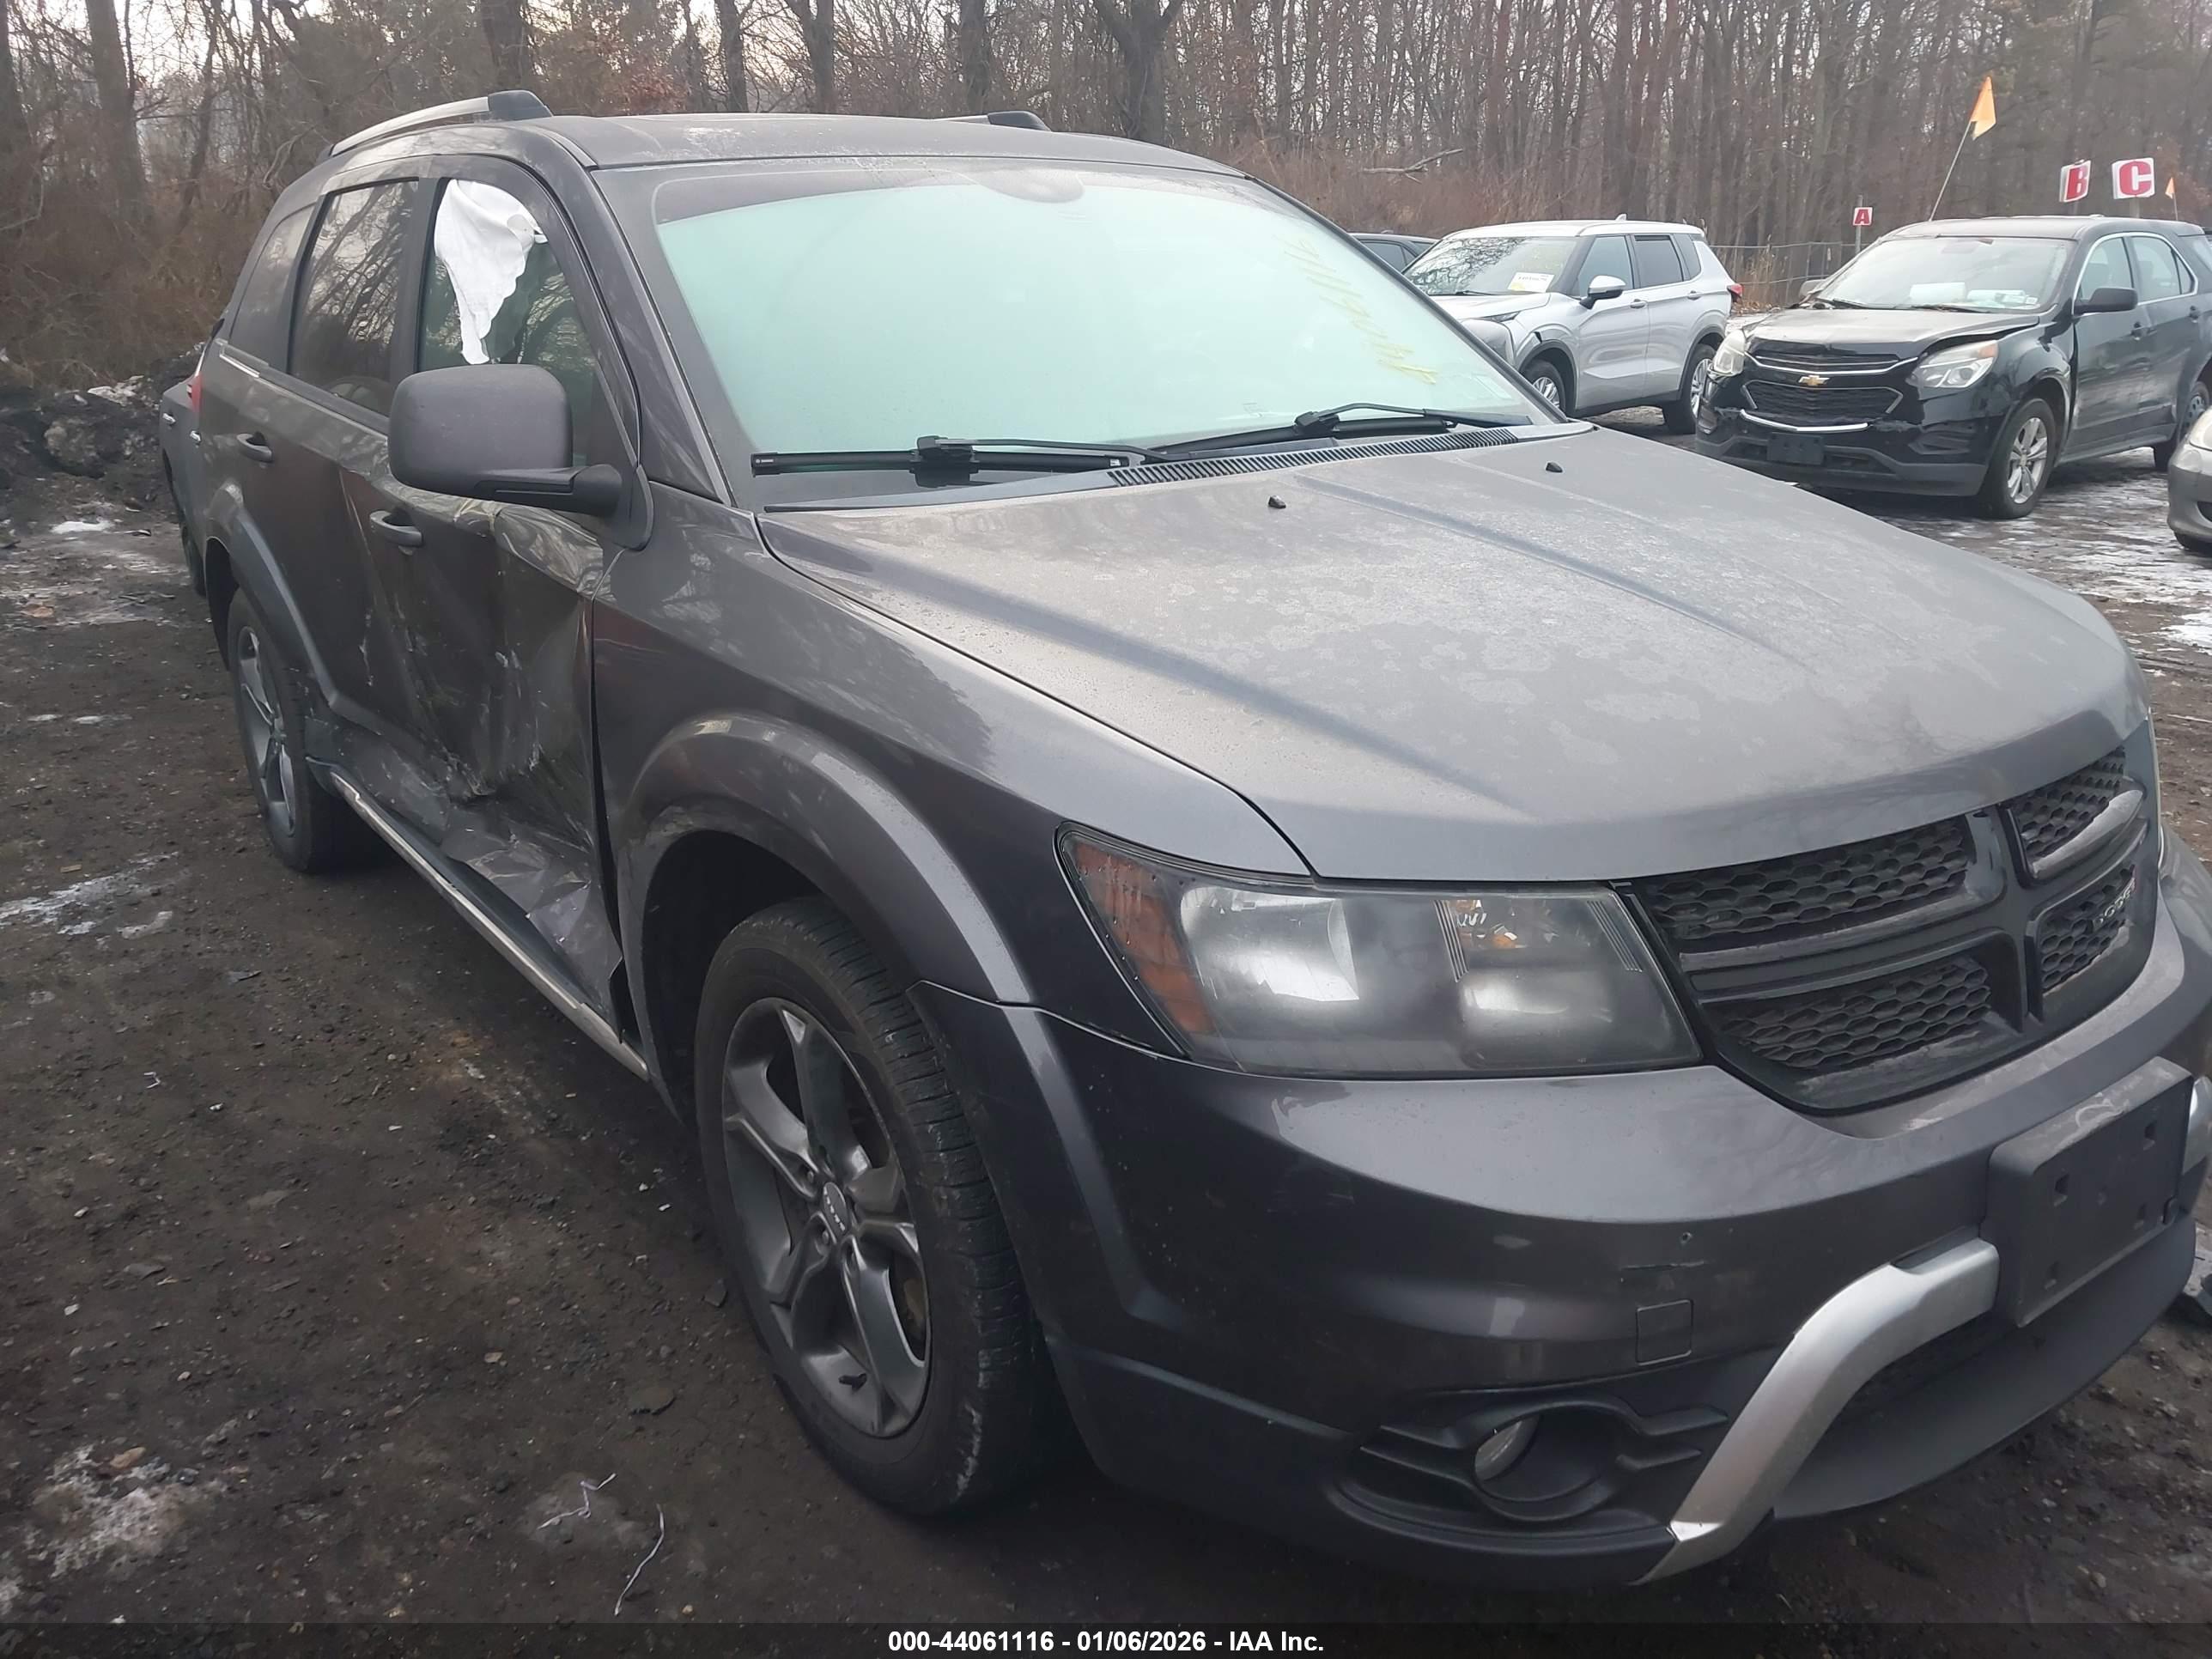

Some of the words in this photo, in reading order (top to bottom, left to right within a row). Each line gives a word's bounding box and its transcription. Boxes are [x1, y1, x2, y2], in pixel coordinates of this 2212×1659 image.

[2066, 165, 2088, 199] B
[2119, 161, 2152, 196] C
[1854, 209, 1870, 224] A
